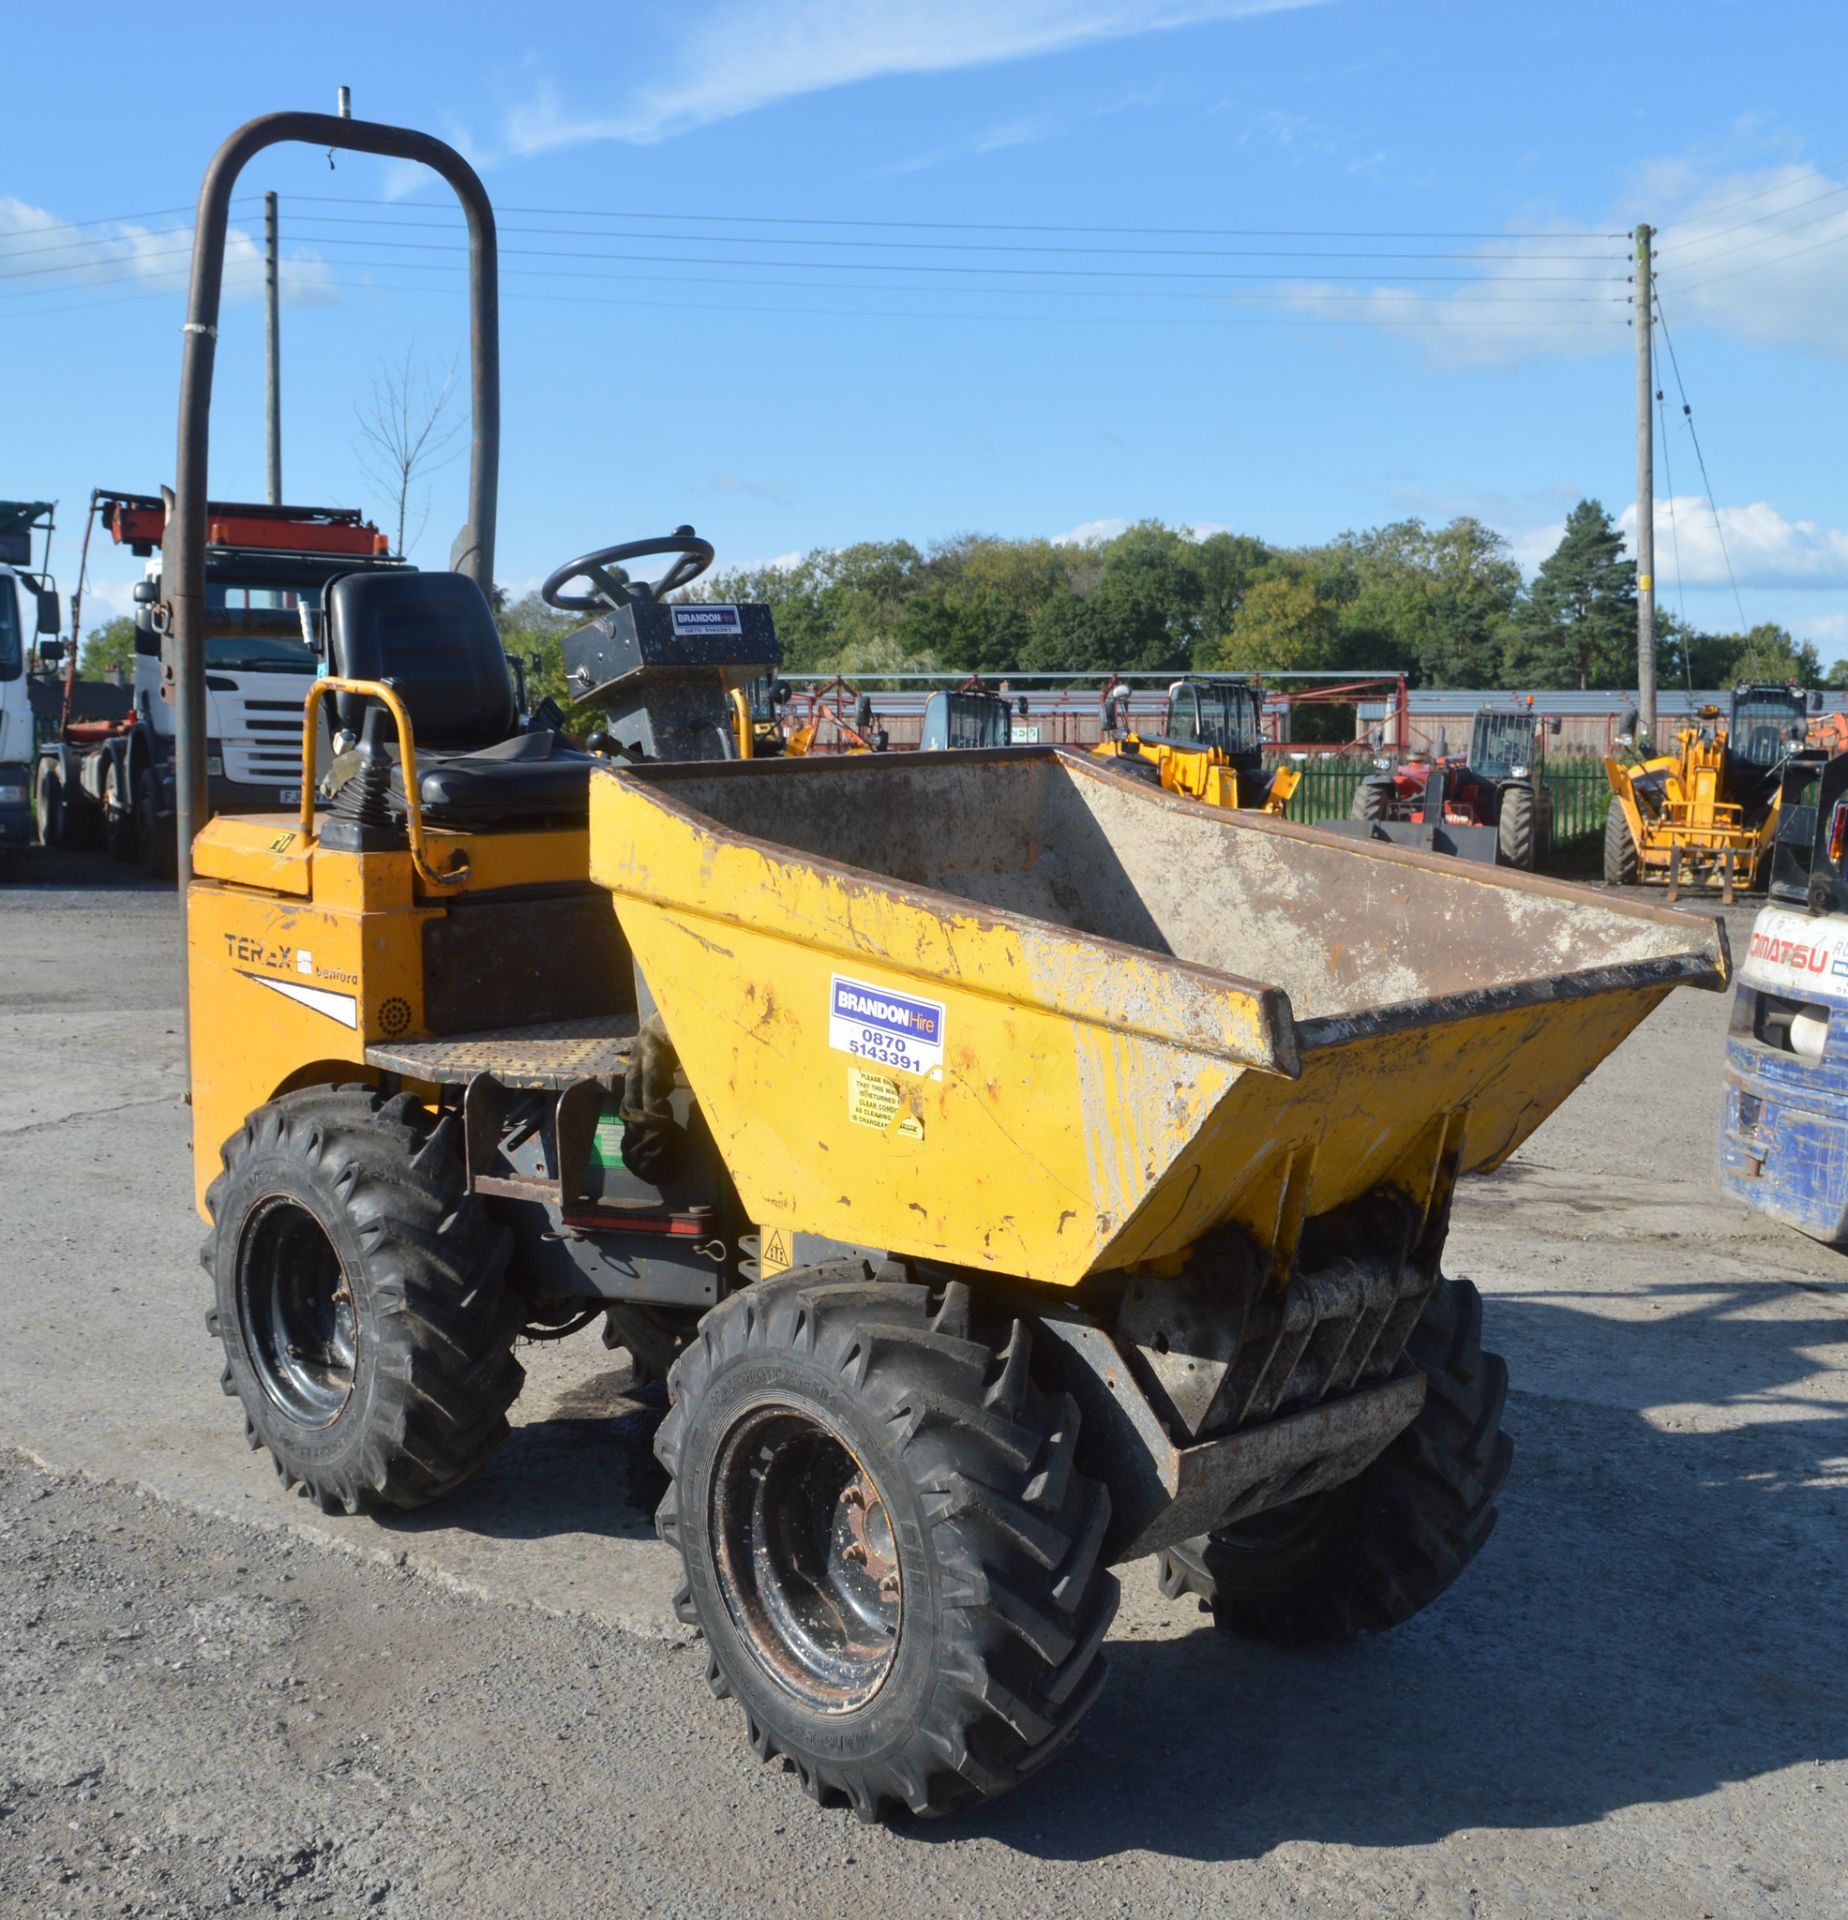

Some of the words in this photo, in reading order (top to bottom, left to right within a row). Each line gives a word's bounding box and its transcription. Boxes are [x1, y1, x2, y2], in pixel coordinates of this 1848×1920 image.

[1750, 933, 1829, 974] OMATSU
[862, 1029, 906, 1053] 0870
[849, 1040, 920, 1073] 5143391
[861, 1073, 881, 1083] PLEASE
[856, 1080, 870, 1089] THAT
[871, 1084, 884, 1093] THIS
[859, 1099, 877, 1108] CLEAN
[864, 1109, 892, 1121] CLEANING
